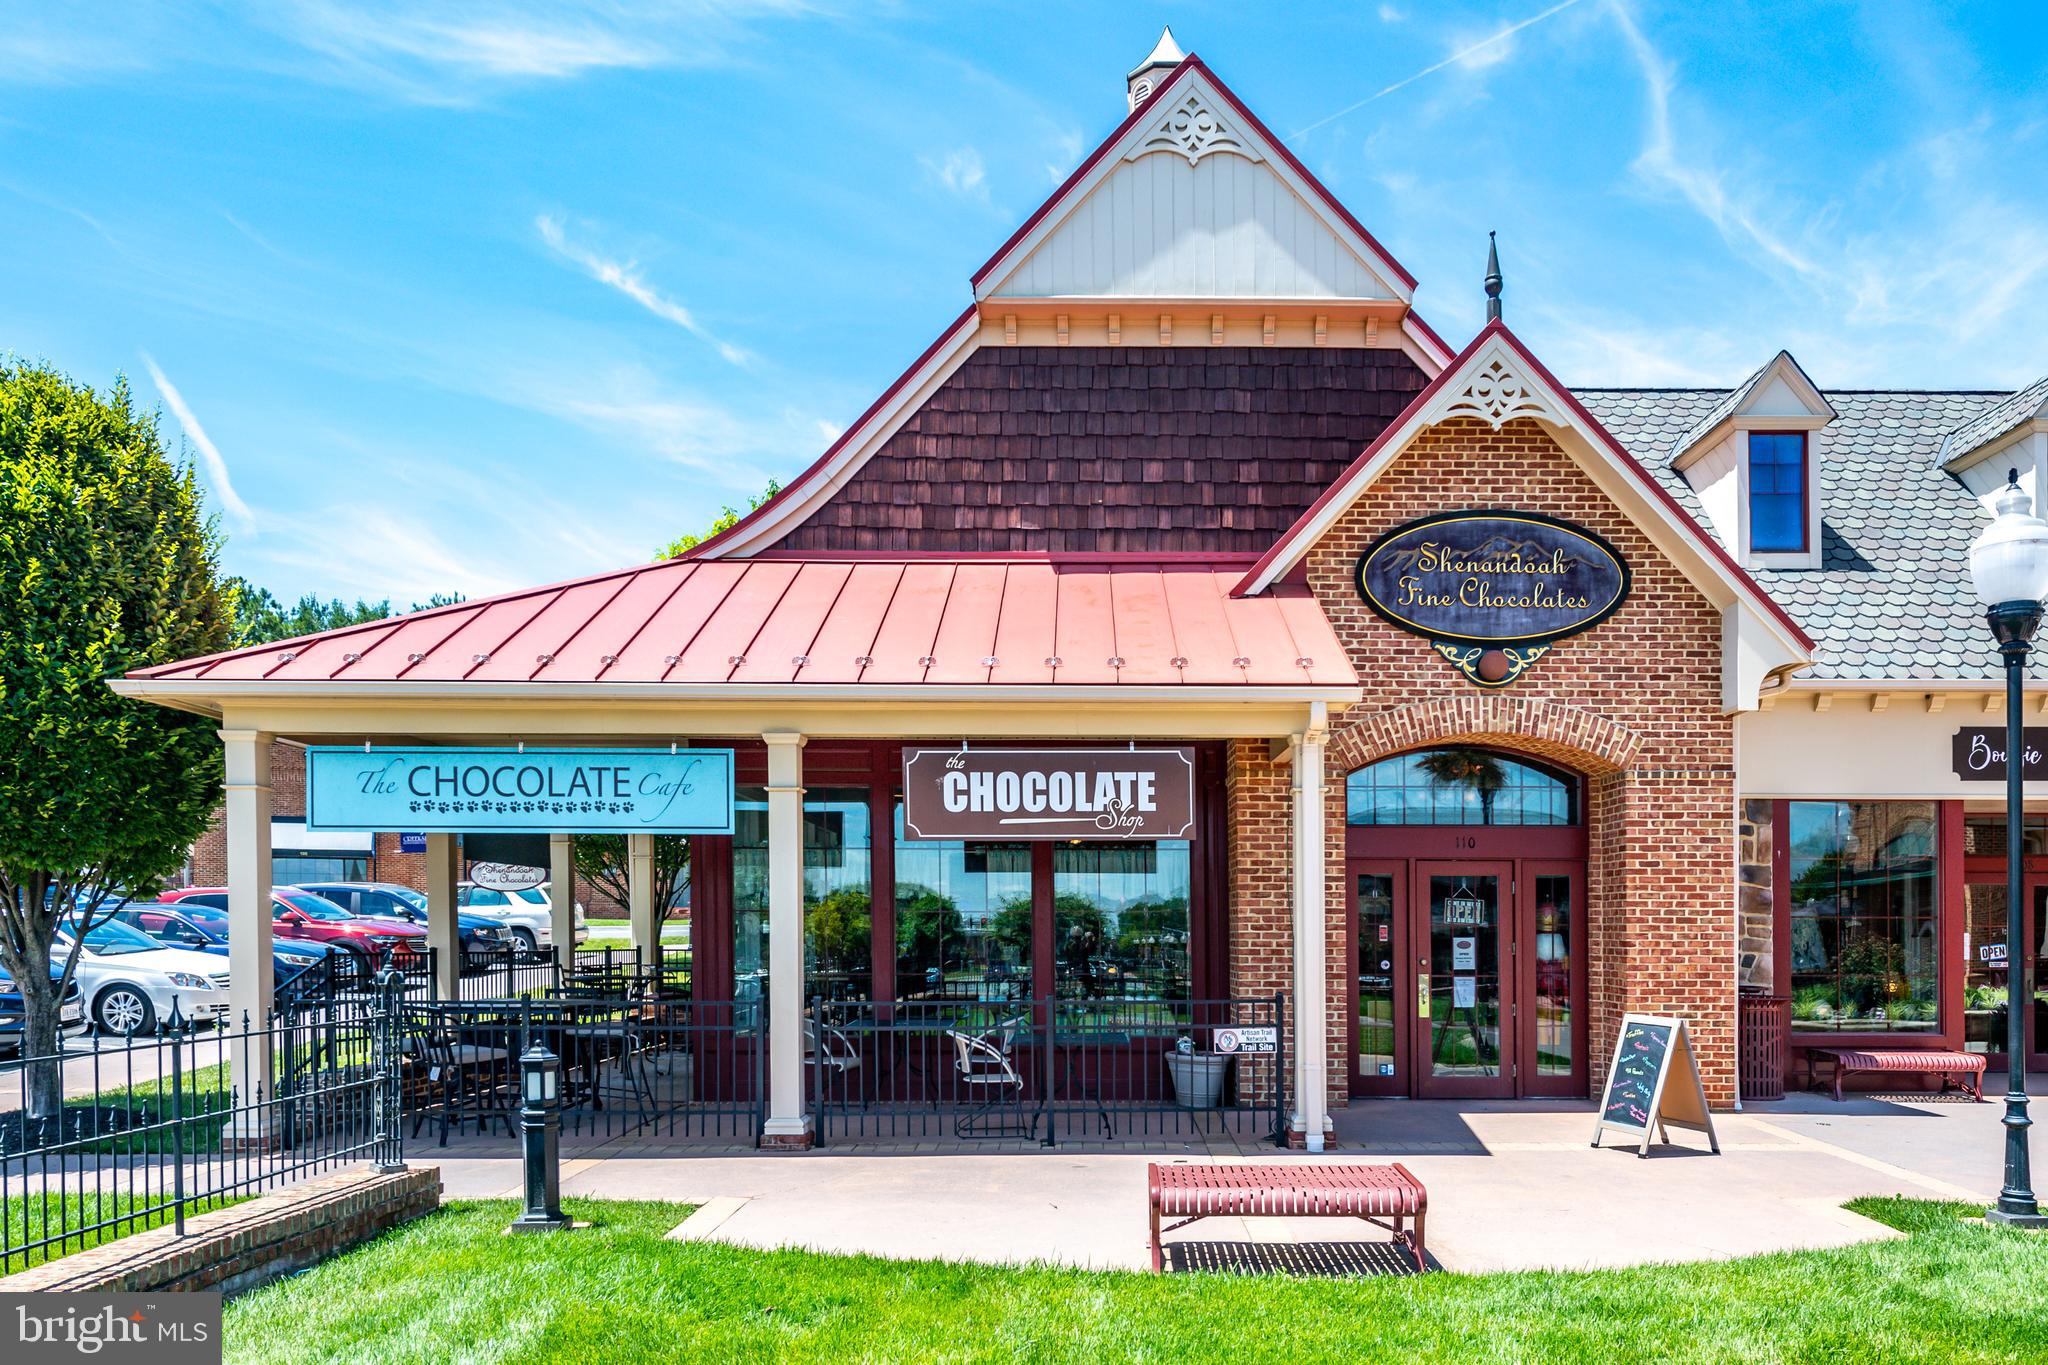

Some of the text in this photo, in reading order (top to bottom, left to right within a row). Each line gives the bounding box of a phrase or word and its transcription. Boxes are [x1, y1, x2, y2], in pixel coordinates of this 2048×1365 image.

[1417, 542, 1574, 575] Shenandoah
[1398, 575, 1593, 609] Fine Chocolates
[945, 751, 965, 769] the
[357, 758, 702, 823] The CHOCOLATE Cafe
[943, 771, 1157, 813] CHOCOLATE
[1095, 798, 1145, 838] Shop
[1455, 836, 1476, 849] 110
[500, 873, 539, 884] Chocolates
[1981, 945, 2006, 959] OPEN
[1241, 1043, 1274, 1051] Trail Site
